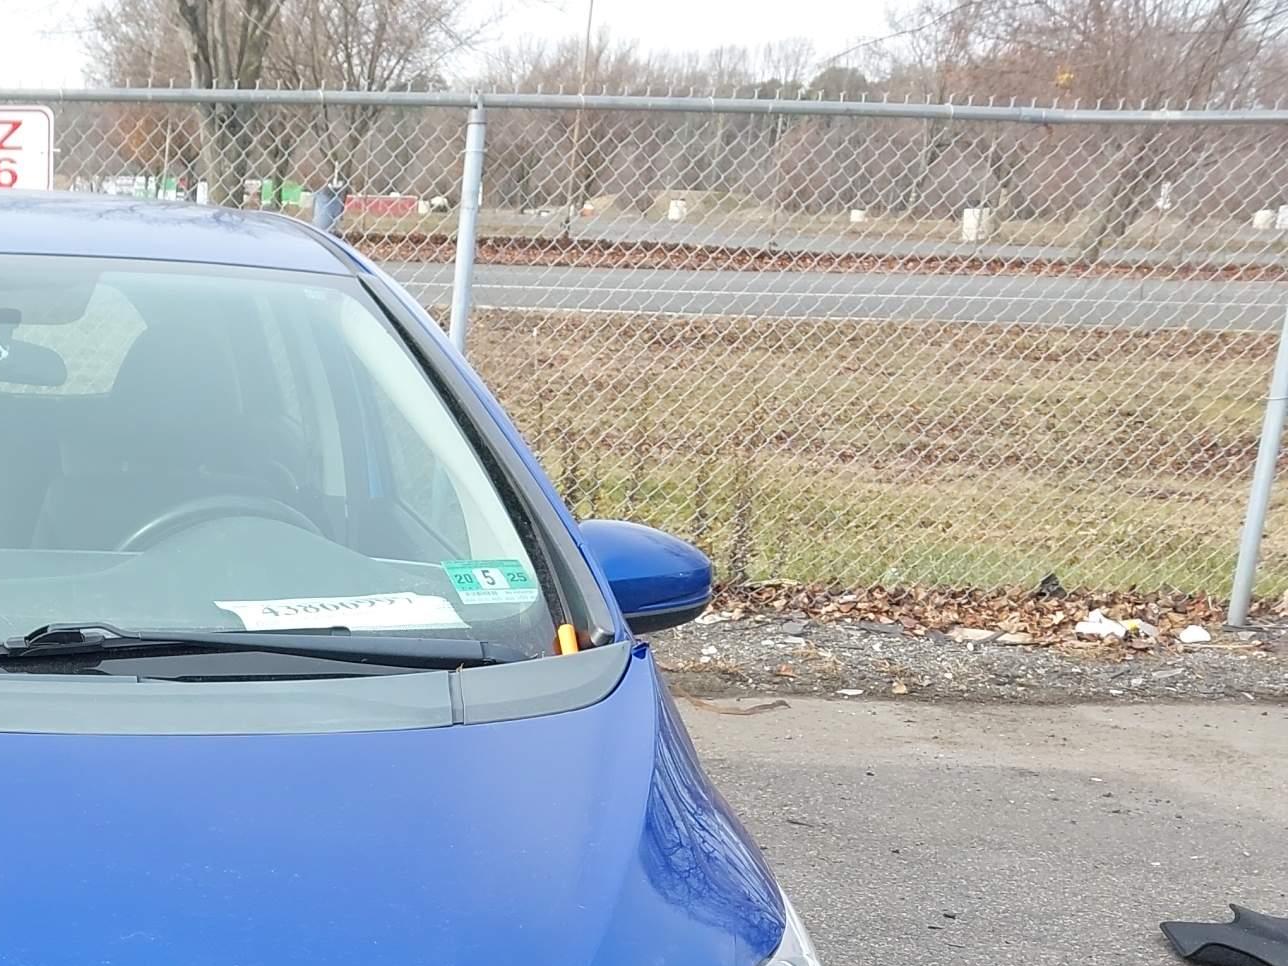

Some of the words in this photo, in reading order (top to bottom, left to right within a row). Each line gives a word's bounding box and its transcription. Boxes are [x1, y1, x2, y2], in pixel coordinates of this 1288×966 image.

[454, 573, 474, 585] 20
[480, 569, 497, 586] 5
[506, 572, 528, 583] 25
